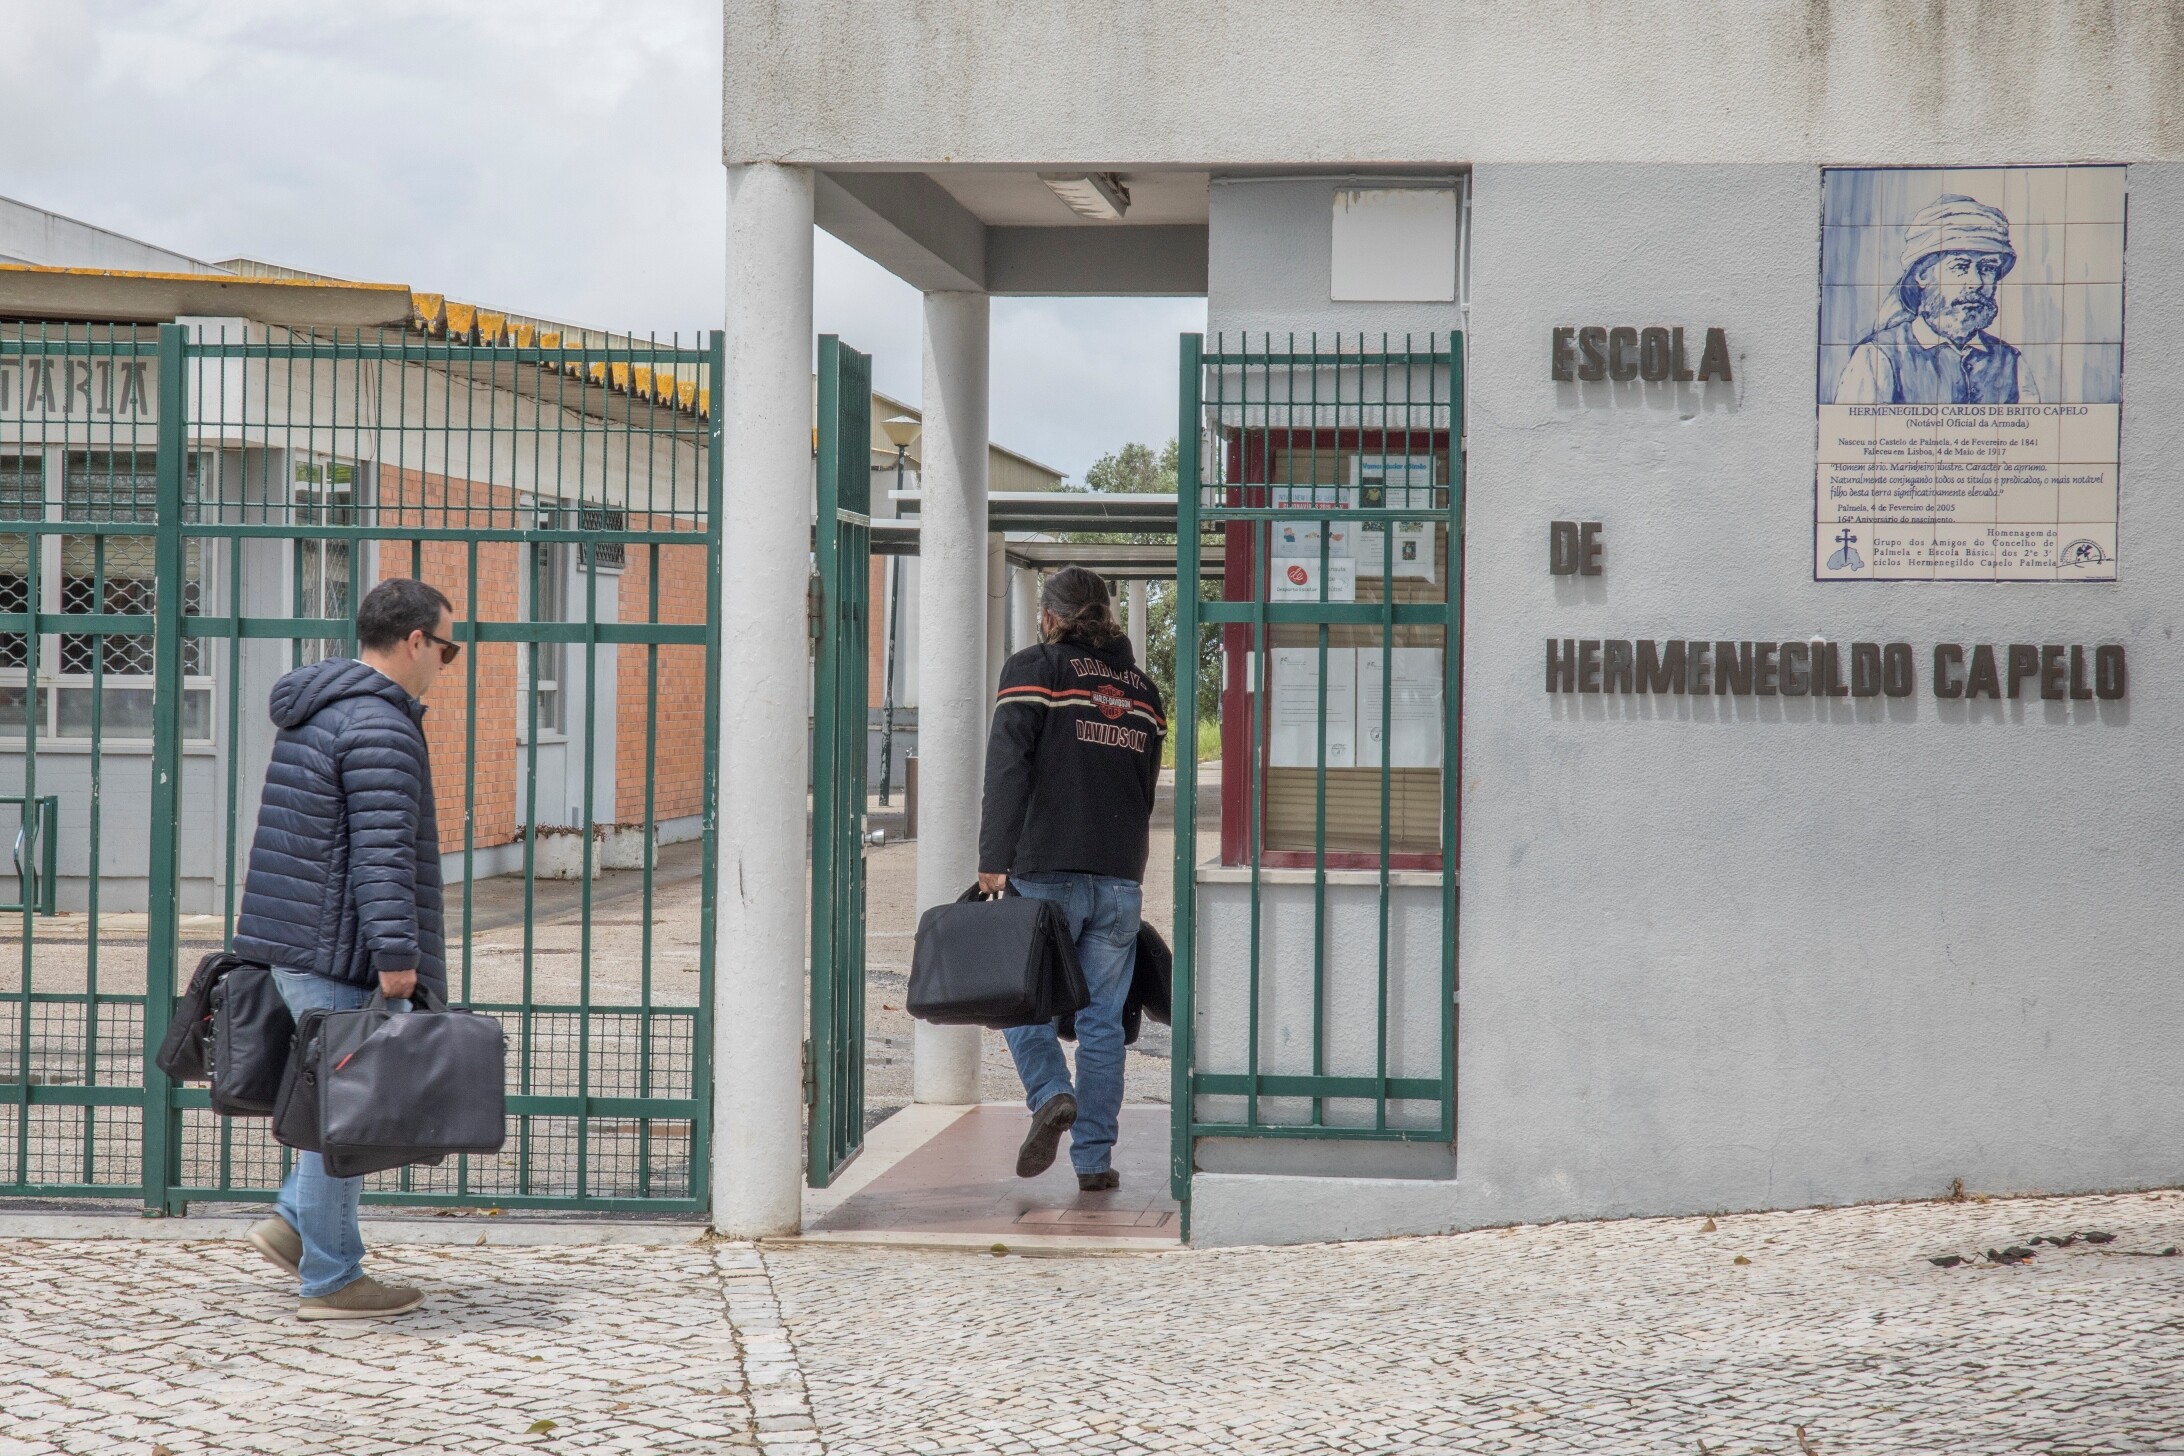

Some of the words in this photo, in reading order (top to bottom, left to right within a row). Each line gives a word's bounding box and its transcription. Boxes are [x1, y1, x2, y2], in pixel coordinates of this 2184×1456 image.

[1552, 327, 1732, 381] ESCOLA
[1849, 407, 1938, 416] HERMENEGILDO
[1941, 407, 1986, 416] CARLOS
[1988, 407, 2004, 416] DE
[2007, 407, 2040, 416] BRITO
[2043, 407, 2088, 416] CAPELO
[1906, 418, 1943, 429] (Notável
[1946, 419, 1976, 427] Oficial
[1978, 419, 1989, 427] da
[1991, 419, 2029, 429] Armada)
[1838, 438, 1865, 446] Nasceu
[1879, 438, 1907, 446] Castelo
[1909, 438, 1917, 446] de
[1961, 438, 1969, 446] de
[1971, 438, 2007, 446] Fevereiro
[2009, 438, 2018, 446] de
[2021, 438, 2038, 446] 1841
[1907, 448, 1935, 457] Lisboa,
[1943, 448, 1953, 456] de
[1954, 448, 1974, 456] Maio
[1976, 448, 1985, 456] de
[1988, 448, 2006, 456] 1917
[1890, 460, 1934, 472] Marinheiro
[1937, 460, 1963, 471] ilustre.
[2003, 461, 2012, 471] de
[2014, 464, 2047, 473] aprumo.
[1830, 473, 1887, 484] Naturalmente
[1889, 476, 1933, 486] conjugando
[1935, 475, 1954, 483] todos
[2001, 476, 2042, 486] predicados,
[2051, 475, 2070, 484] mais
[2072, 473, 2103, 484] notável
[1830, 486, 1847, 500] filho
[1850, 487, 1869, 497] desta
[1871, 489, 1891, 497] terra
[1894, 486, 1966, 499] significativamente
[1837, 504, 1868, 512] Palmela,
[1878, 504, 1887, 512] de
[1889, 504, 1923, 512] Fevereiro
[1926, 504, 1934, 512] de
[1936, 504, 1956, 512] 2005
[1987, 529, 2044, 538] Homenagem
[2046, 529, 2057, 537] do
[1550, 521, 1602, 575] DE
[1873, 539, 1902, 548] Grupo
[1931, 539, 1967, 548] Amigos
[1992, 539, 2036, 547] Concelho
[2043, 539, 2054, 547] de
[2002, 549, 2018, 557] dos
[1908, 559, 1974, 567] Hermenegildo
[1980, 559, 2013, 568] Capelo
[2020, 559, 2057, 567] Palmela
[1546, 639, 1912, 697] HERMENEGILDO
[1934, 643, 2125, 700] CAPELO
[1092, 693, 1131, 708] HARLEY-DAVIDSON
[1076, 719, 1147, 752] DAVIDSON
